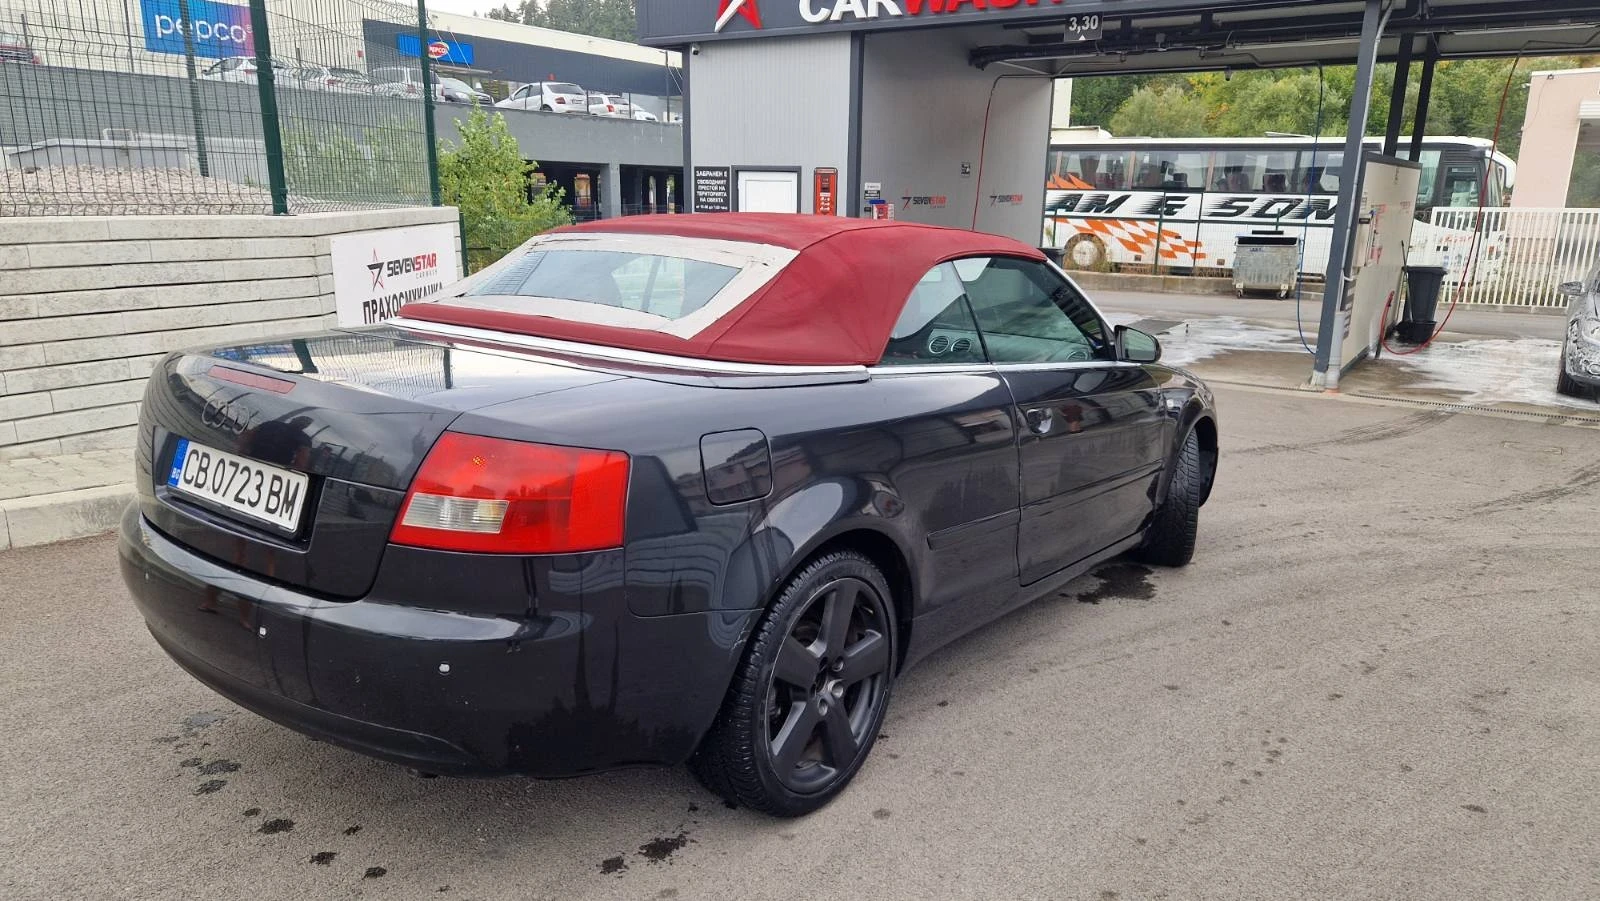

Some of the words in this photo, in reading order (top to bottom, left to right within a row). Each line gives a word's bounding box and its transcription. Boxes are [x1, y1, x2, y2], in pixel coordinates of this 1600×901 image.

[1069, 15, 1099, 33] 3,30
[387, 253, 437, 277] SEVENSTAR
[183, 449, 211, 488] CB
[212, 458, 264, 508] 0723
[265, 474, 300, 521] BM
